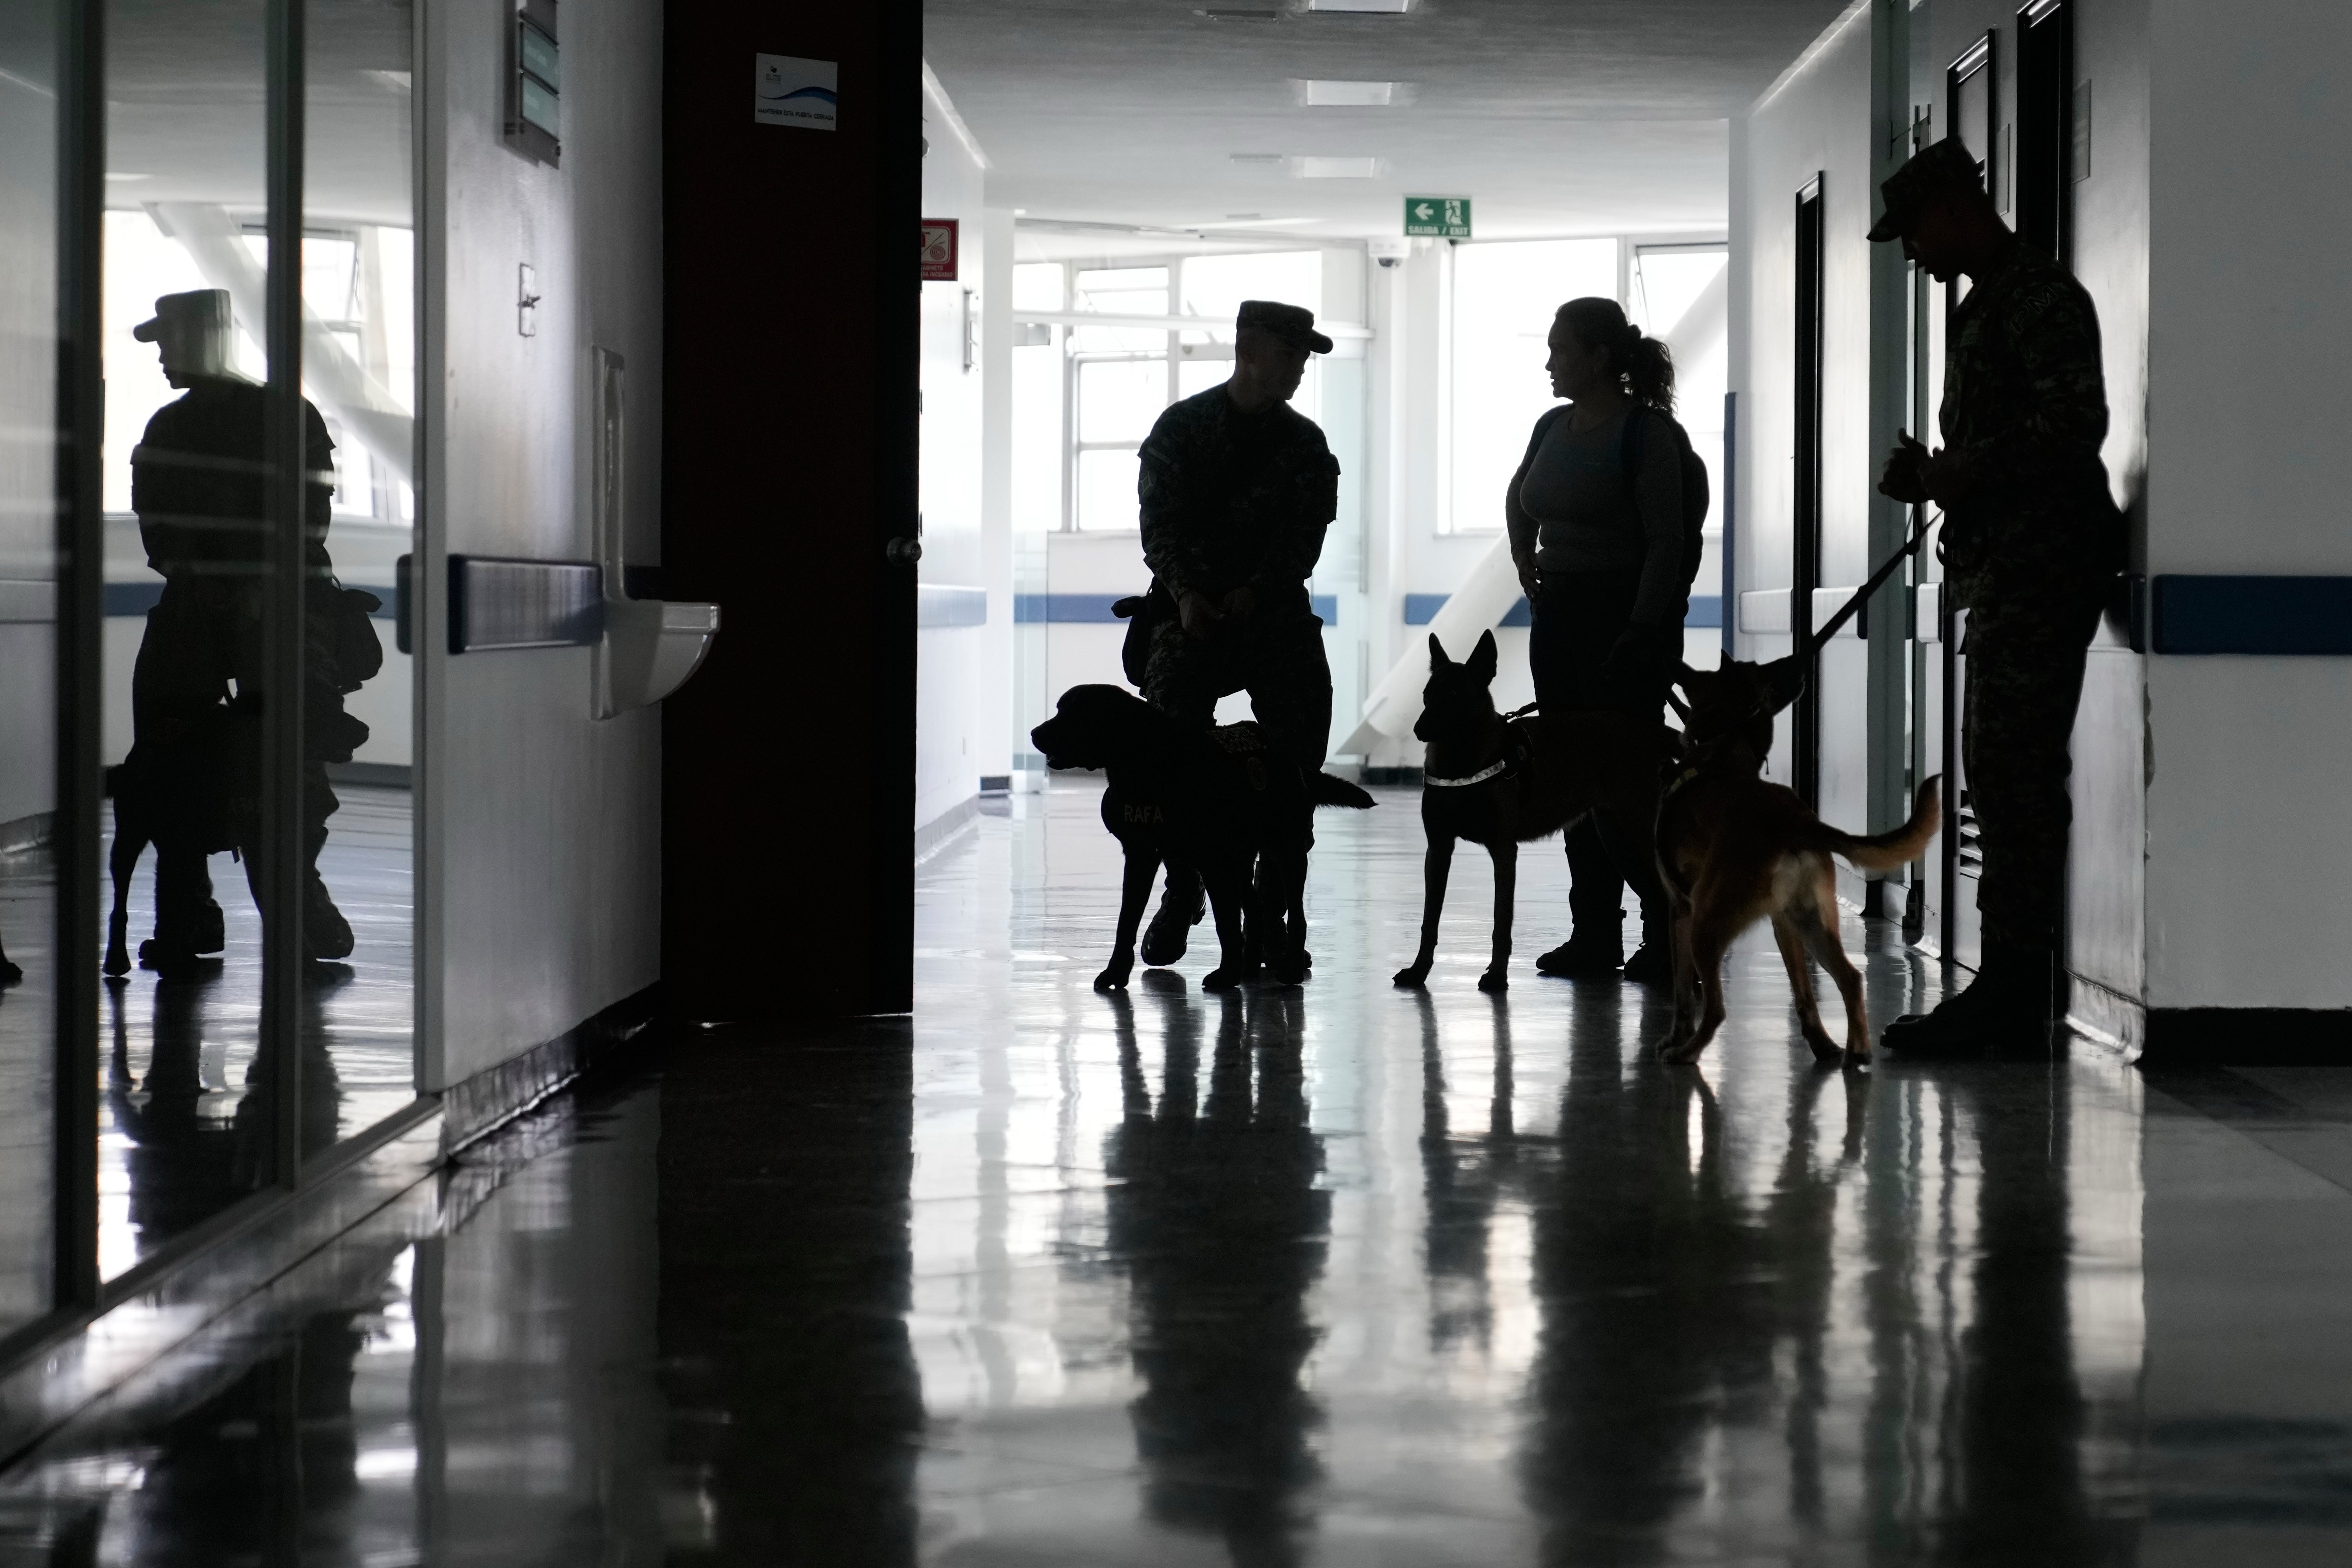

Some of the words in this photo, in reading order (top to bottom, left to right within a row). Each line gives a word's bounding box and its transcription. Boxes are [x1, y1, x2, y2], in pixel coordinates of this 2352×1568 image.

[1408, 225, 1439, 235] SALIDA
[1449, 227, 1468, 235] EXIT
[2010, 285, 2058, 334] PM
[1123, 805, 1163, 823] RAFA
